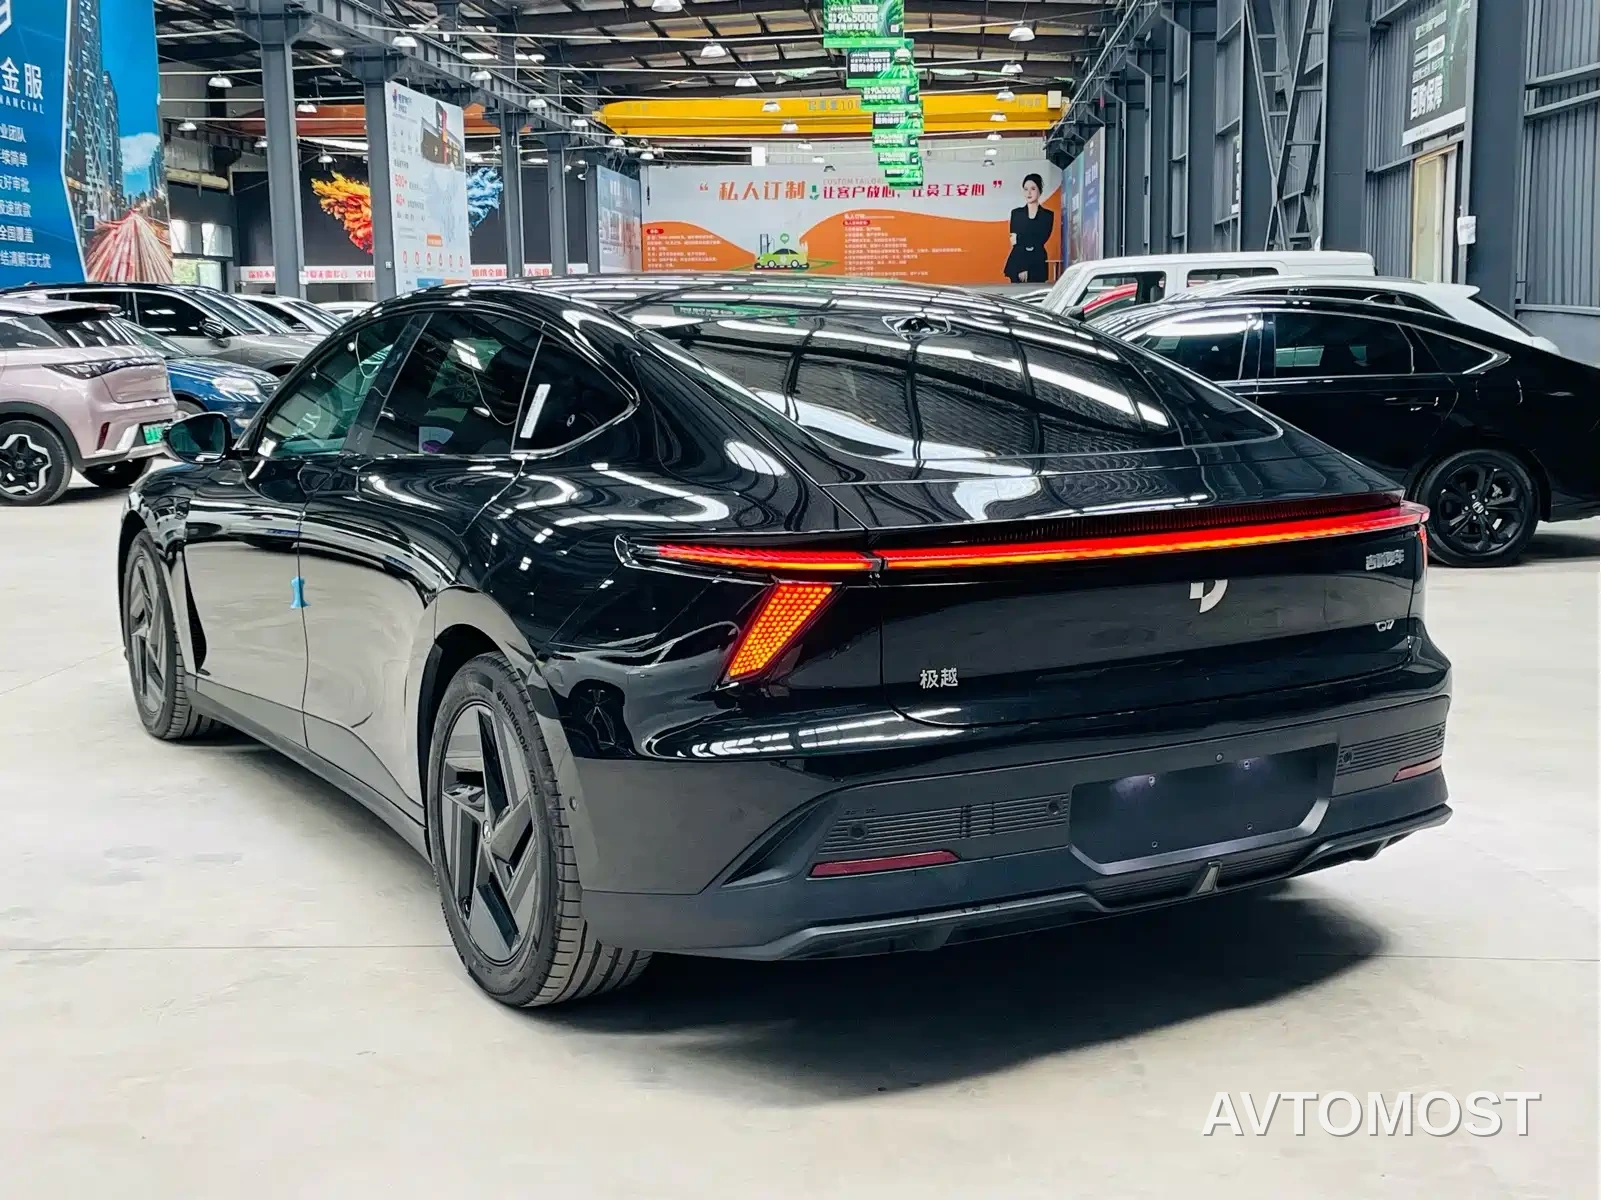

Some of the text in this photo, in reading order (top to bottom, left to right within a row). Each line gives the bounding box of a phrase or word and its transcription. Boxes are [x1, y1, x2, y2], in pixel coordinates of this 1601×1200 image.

[0, 56, 43, 100] 金服
[0, 148, 28, 168] 续简单
[718, 181, 806, 201] 私人订制
[0, 224, 34, 243] 全国覆盖
[919, 667, 959, 689] 极越
